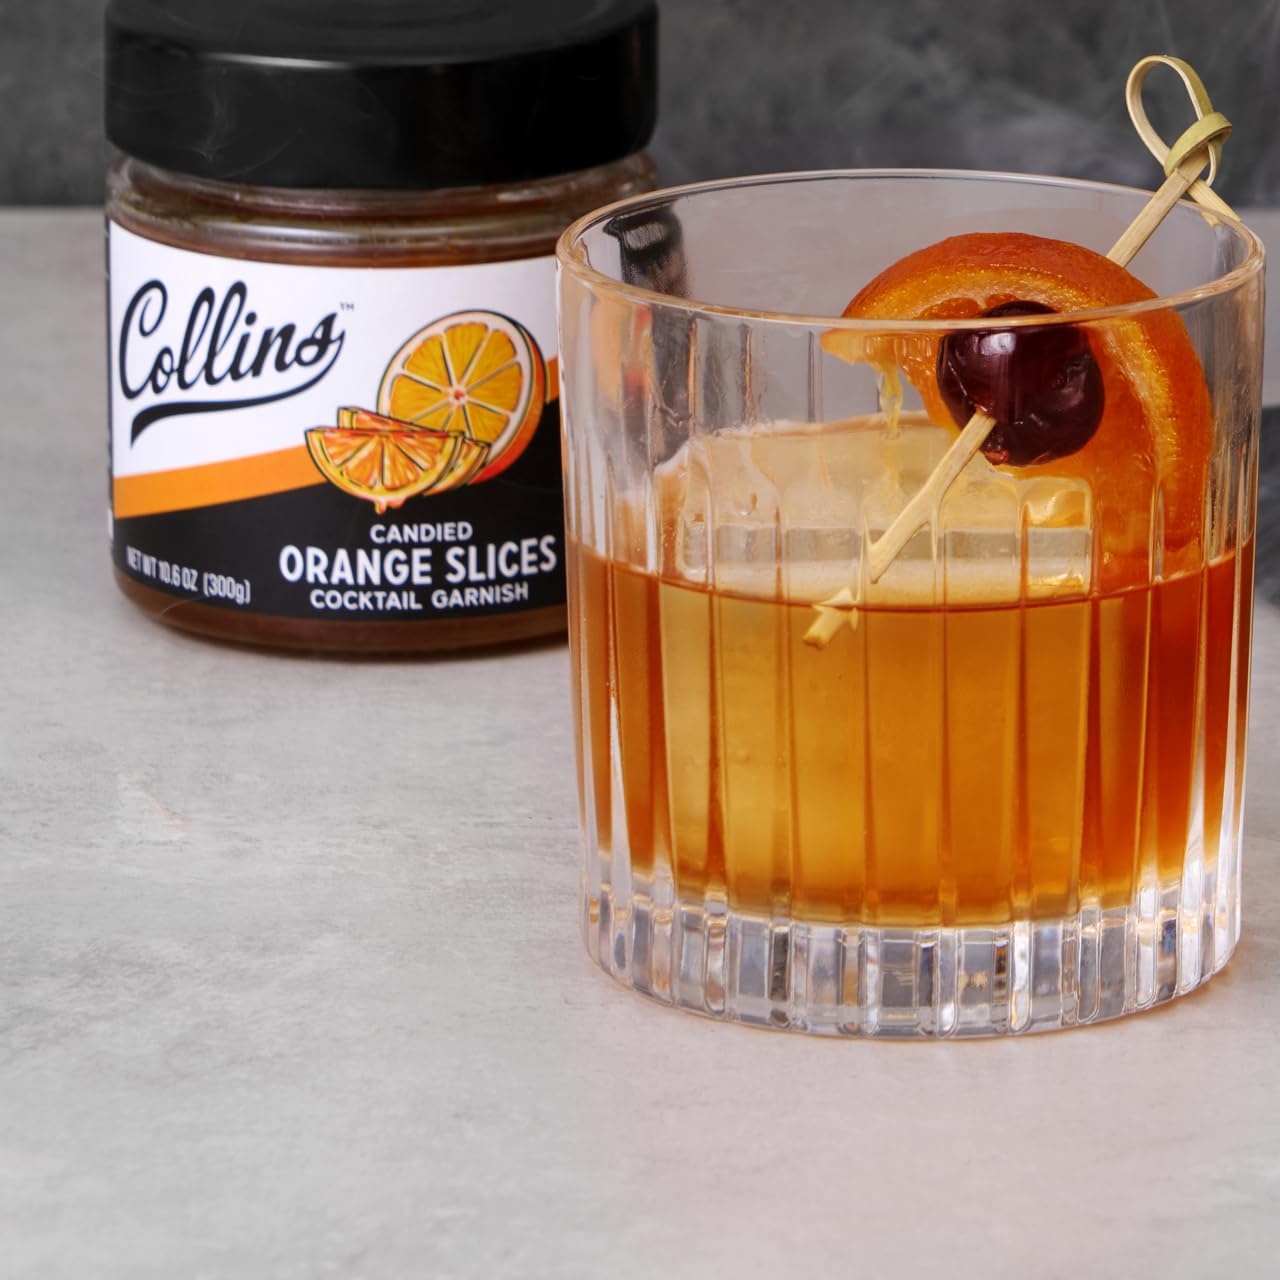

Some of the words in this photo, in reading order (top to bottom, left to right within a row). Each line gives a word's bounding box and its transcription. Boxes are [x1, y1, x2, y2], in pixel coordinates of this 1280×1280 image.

[119, 279, 346, 449] Collins
[370, 522, 473, 544] CANDIED
[158, 560, 180, 588] 10.6
[181, 567, 198, 592] OZ
[203, 572, 251, 605] (300g)
[279, 544, 432, 586] ORANGE
[445, 536, 558, 581] SLICES
[310, 589, 423, 611] COCKTAIL
[433, 582, 530, 609] GARNISH
